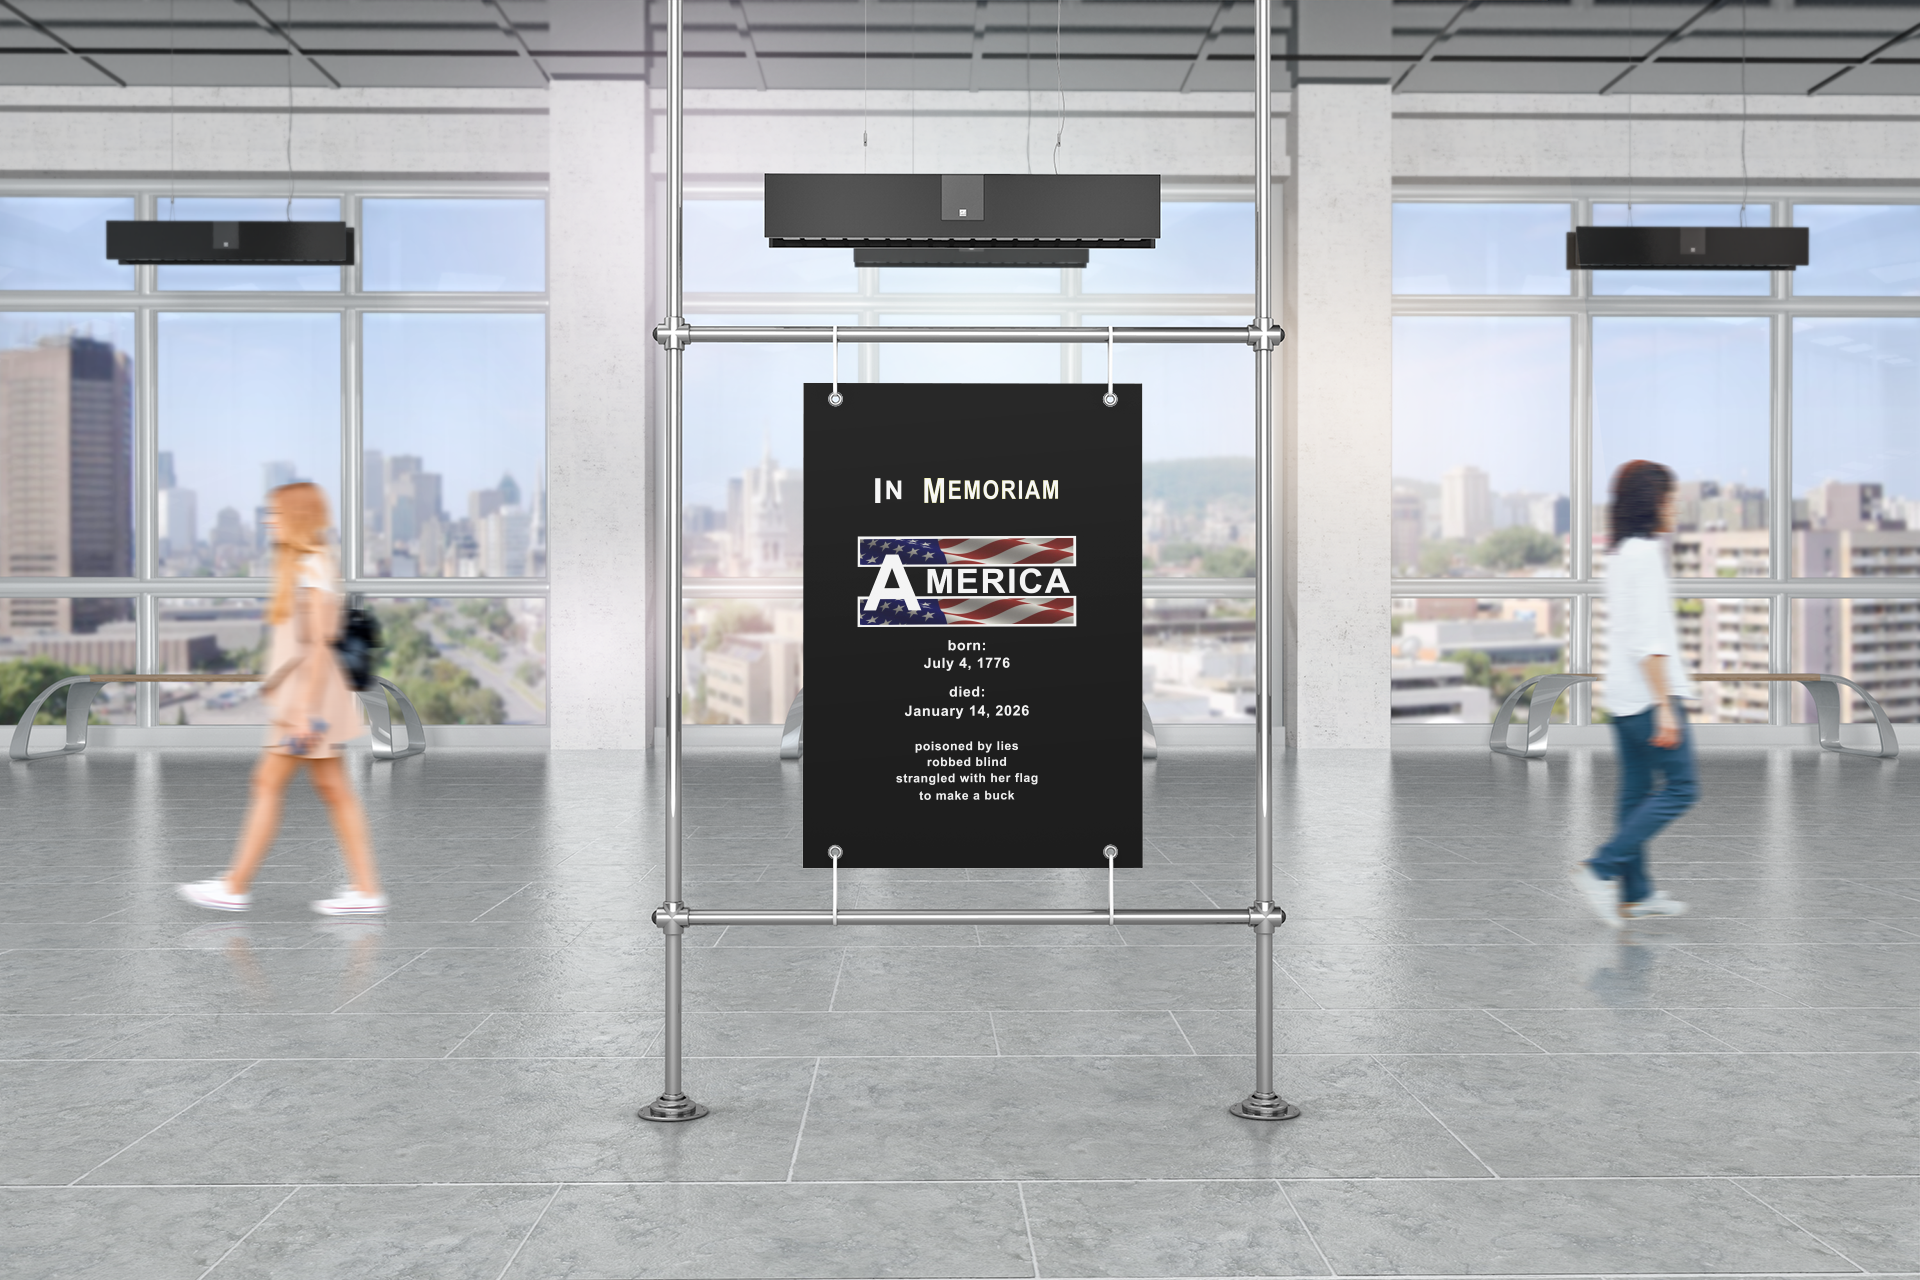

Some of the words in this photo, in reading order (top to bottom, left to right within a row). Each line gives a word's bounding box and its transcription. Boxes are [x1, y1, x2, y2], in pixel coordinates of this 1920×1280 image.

[875, 478, 902, 503] IN
[923, 478, 1059, 503] MEMORIAM
[863, 554, 1071, 611] AMERICA
[948, 639, 986, 651] born:
[923, 657, 954, 671] July
[959, 657, 972, 671] 4,
[977, 657, 1011, 669] 1776
[949, 686, 985, 698] died:
[904, 705, 964, 719] January
[969, 705, 990, 718] 14,
[995, 705, 1030, 717] 2026
[915, 741, 973, 753] poisoned
[978, 741, 993, 753] by
[997, 741, 1019, 752] lies
[927, 756, 971, 767] robbed
[975, 756, 1007, 767] blind
[896, 773, 956, 785] strangled
[960, 773, 986, 783] with
[990, 773, 1011, 783] her
[1015, 772, 1039, 785] flag
[919, 790, 932, 801] to
[936, 790, 969, 801] make
[973, 792, 980, 801] a
[985, 790, 1015, 801] buck
